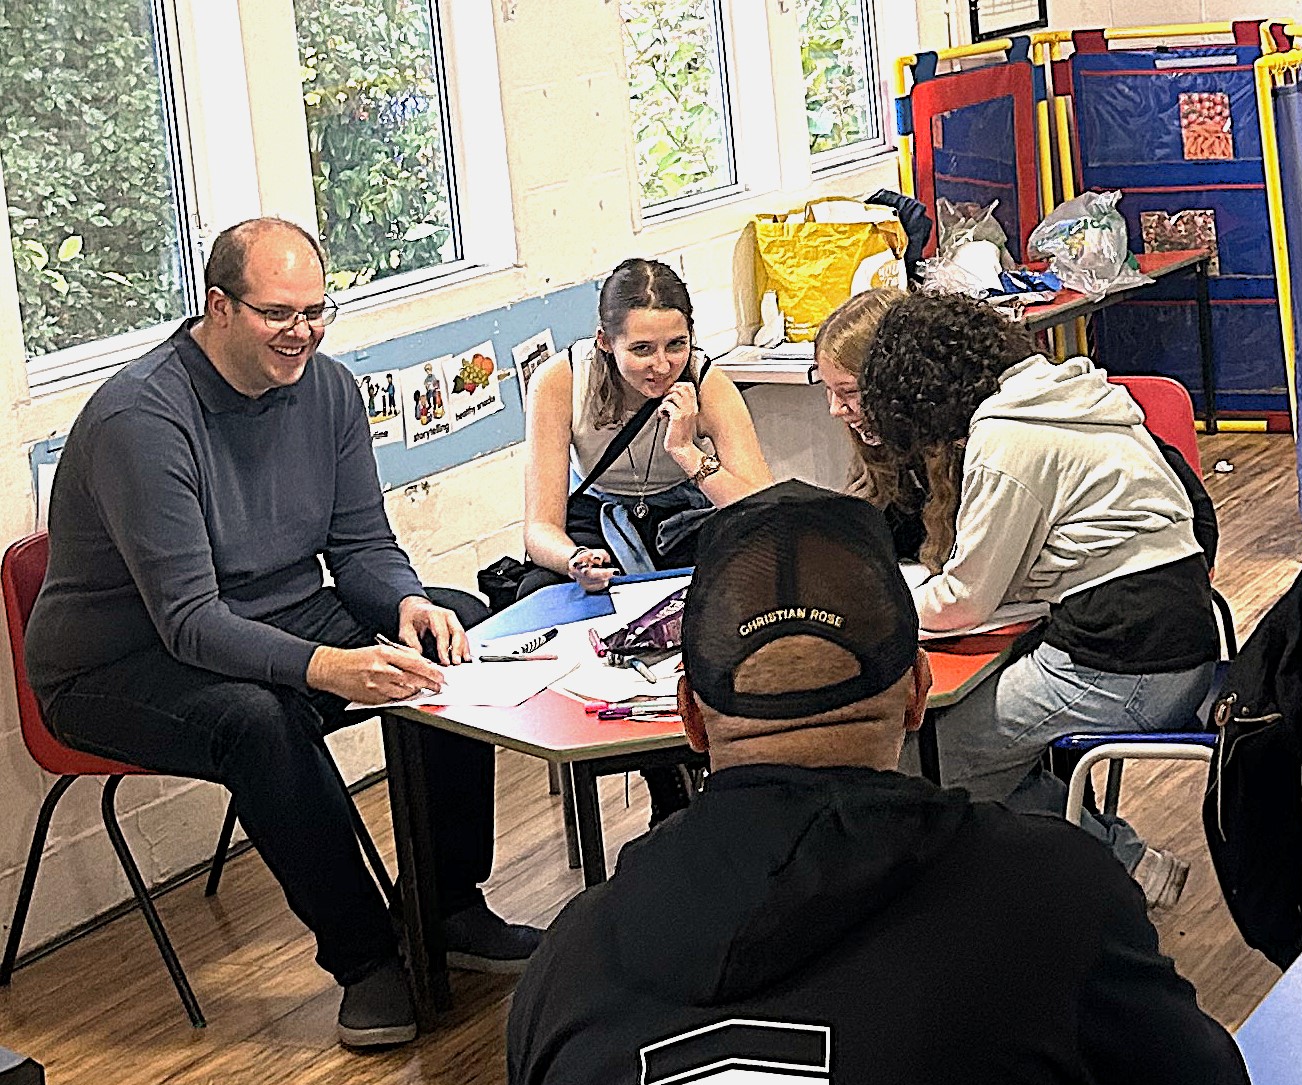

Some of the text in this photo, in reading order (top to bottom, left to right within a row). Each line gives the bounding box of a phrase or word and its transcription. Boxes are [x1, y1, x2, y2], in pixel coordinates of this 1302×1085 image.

[413, 422, 450, 442] storytelling
[739, 608, 844, 636] CHRISTIAN ROSE
